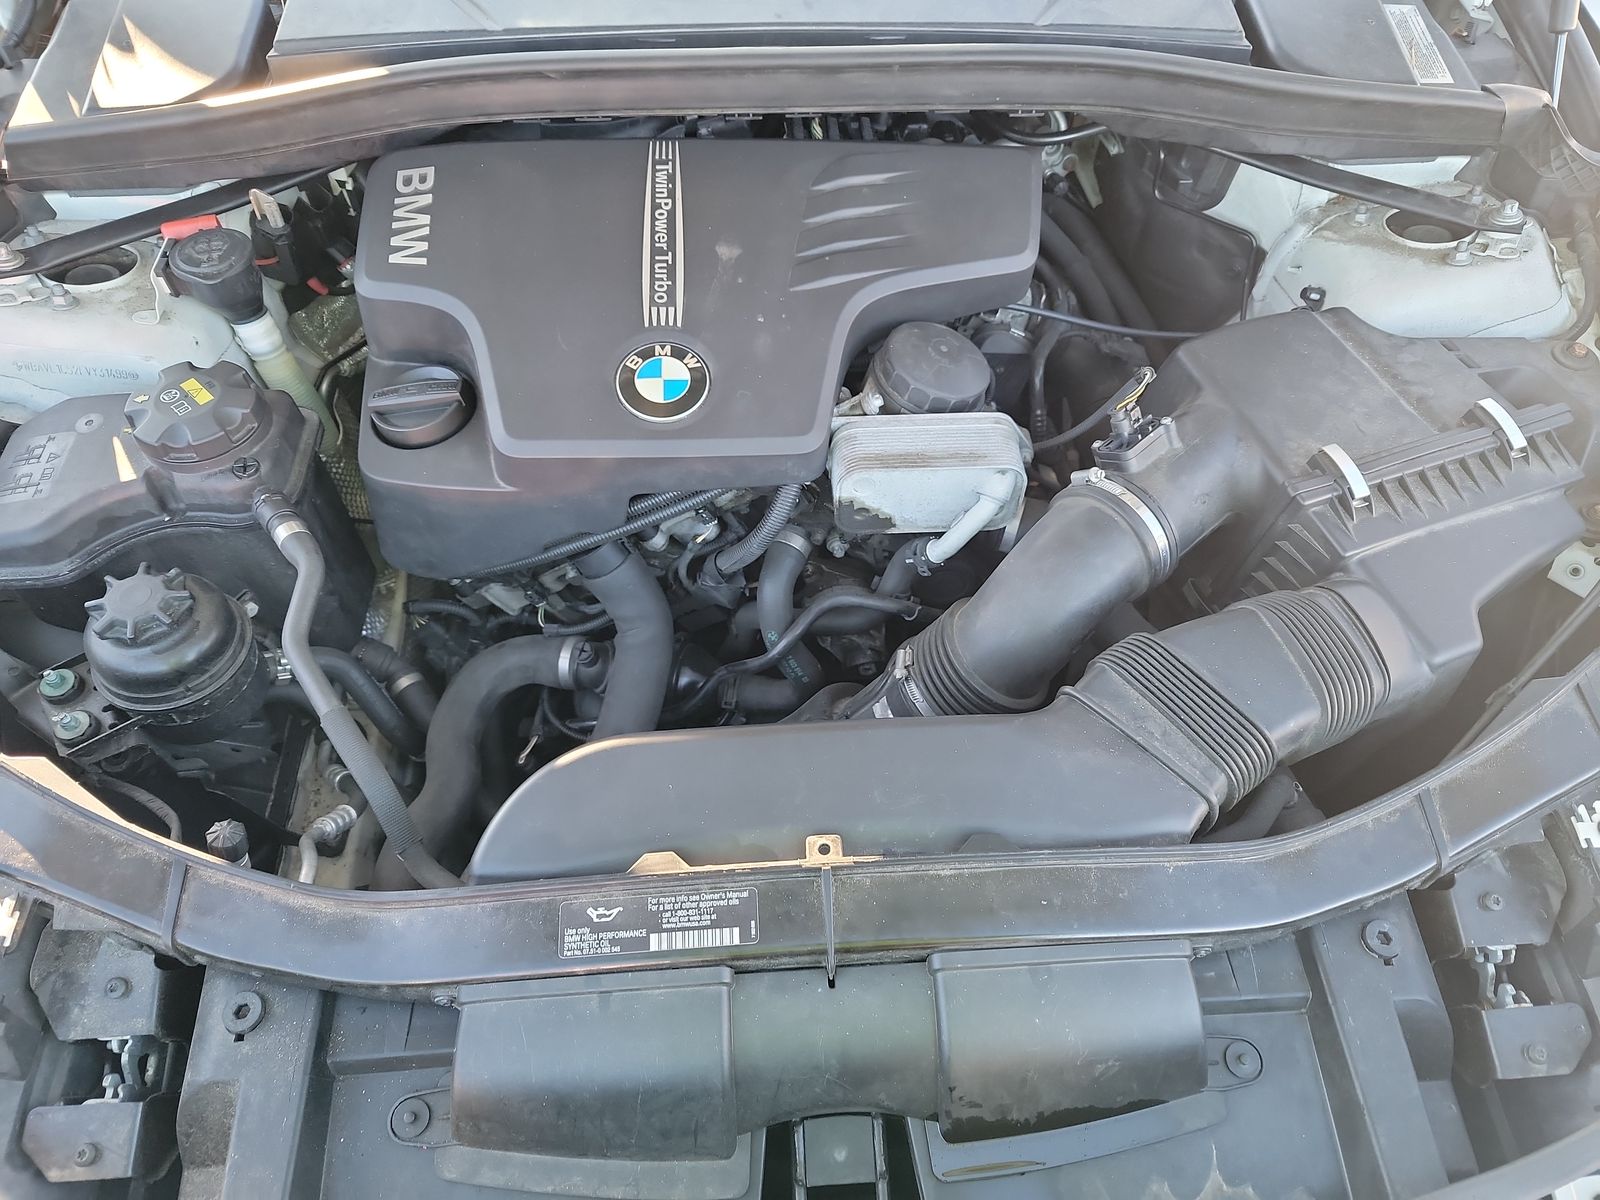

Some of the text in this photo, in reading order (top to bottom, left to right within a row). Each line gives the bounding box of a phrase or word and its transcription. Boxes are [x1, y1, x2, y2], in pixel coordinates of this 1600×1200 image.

[388, 165, 435, 265] BMW
[653, 161, 673, 304] TwinPower Turbo
[624, 344, 702, 370] BMW
[647, 896, 659, 905] For
[675, 894, 688, 903] info
[701, 892, 726, 900] Owner's
[726, 889, 749, 898] Manual
[647, 903, 659, 911] For
[682, 901, 699, 909] other
[699, 898, 728, 908] approved
[564, 926, 591, 936] Use only
[662, 920, 711, 929] www.bmwusa.com
[564, 929, 647, 943] BMW HIGH PERFORMANCE
[563, 939, 611, 951] SYNTHETIC OIL
